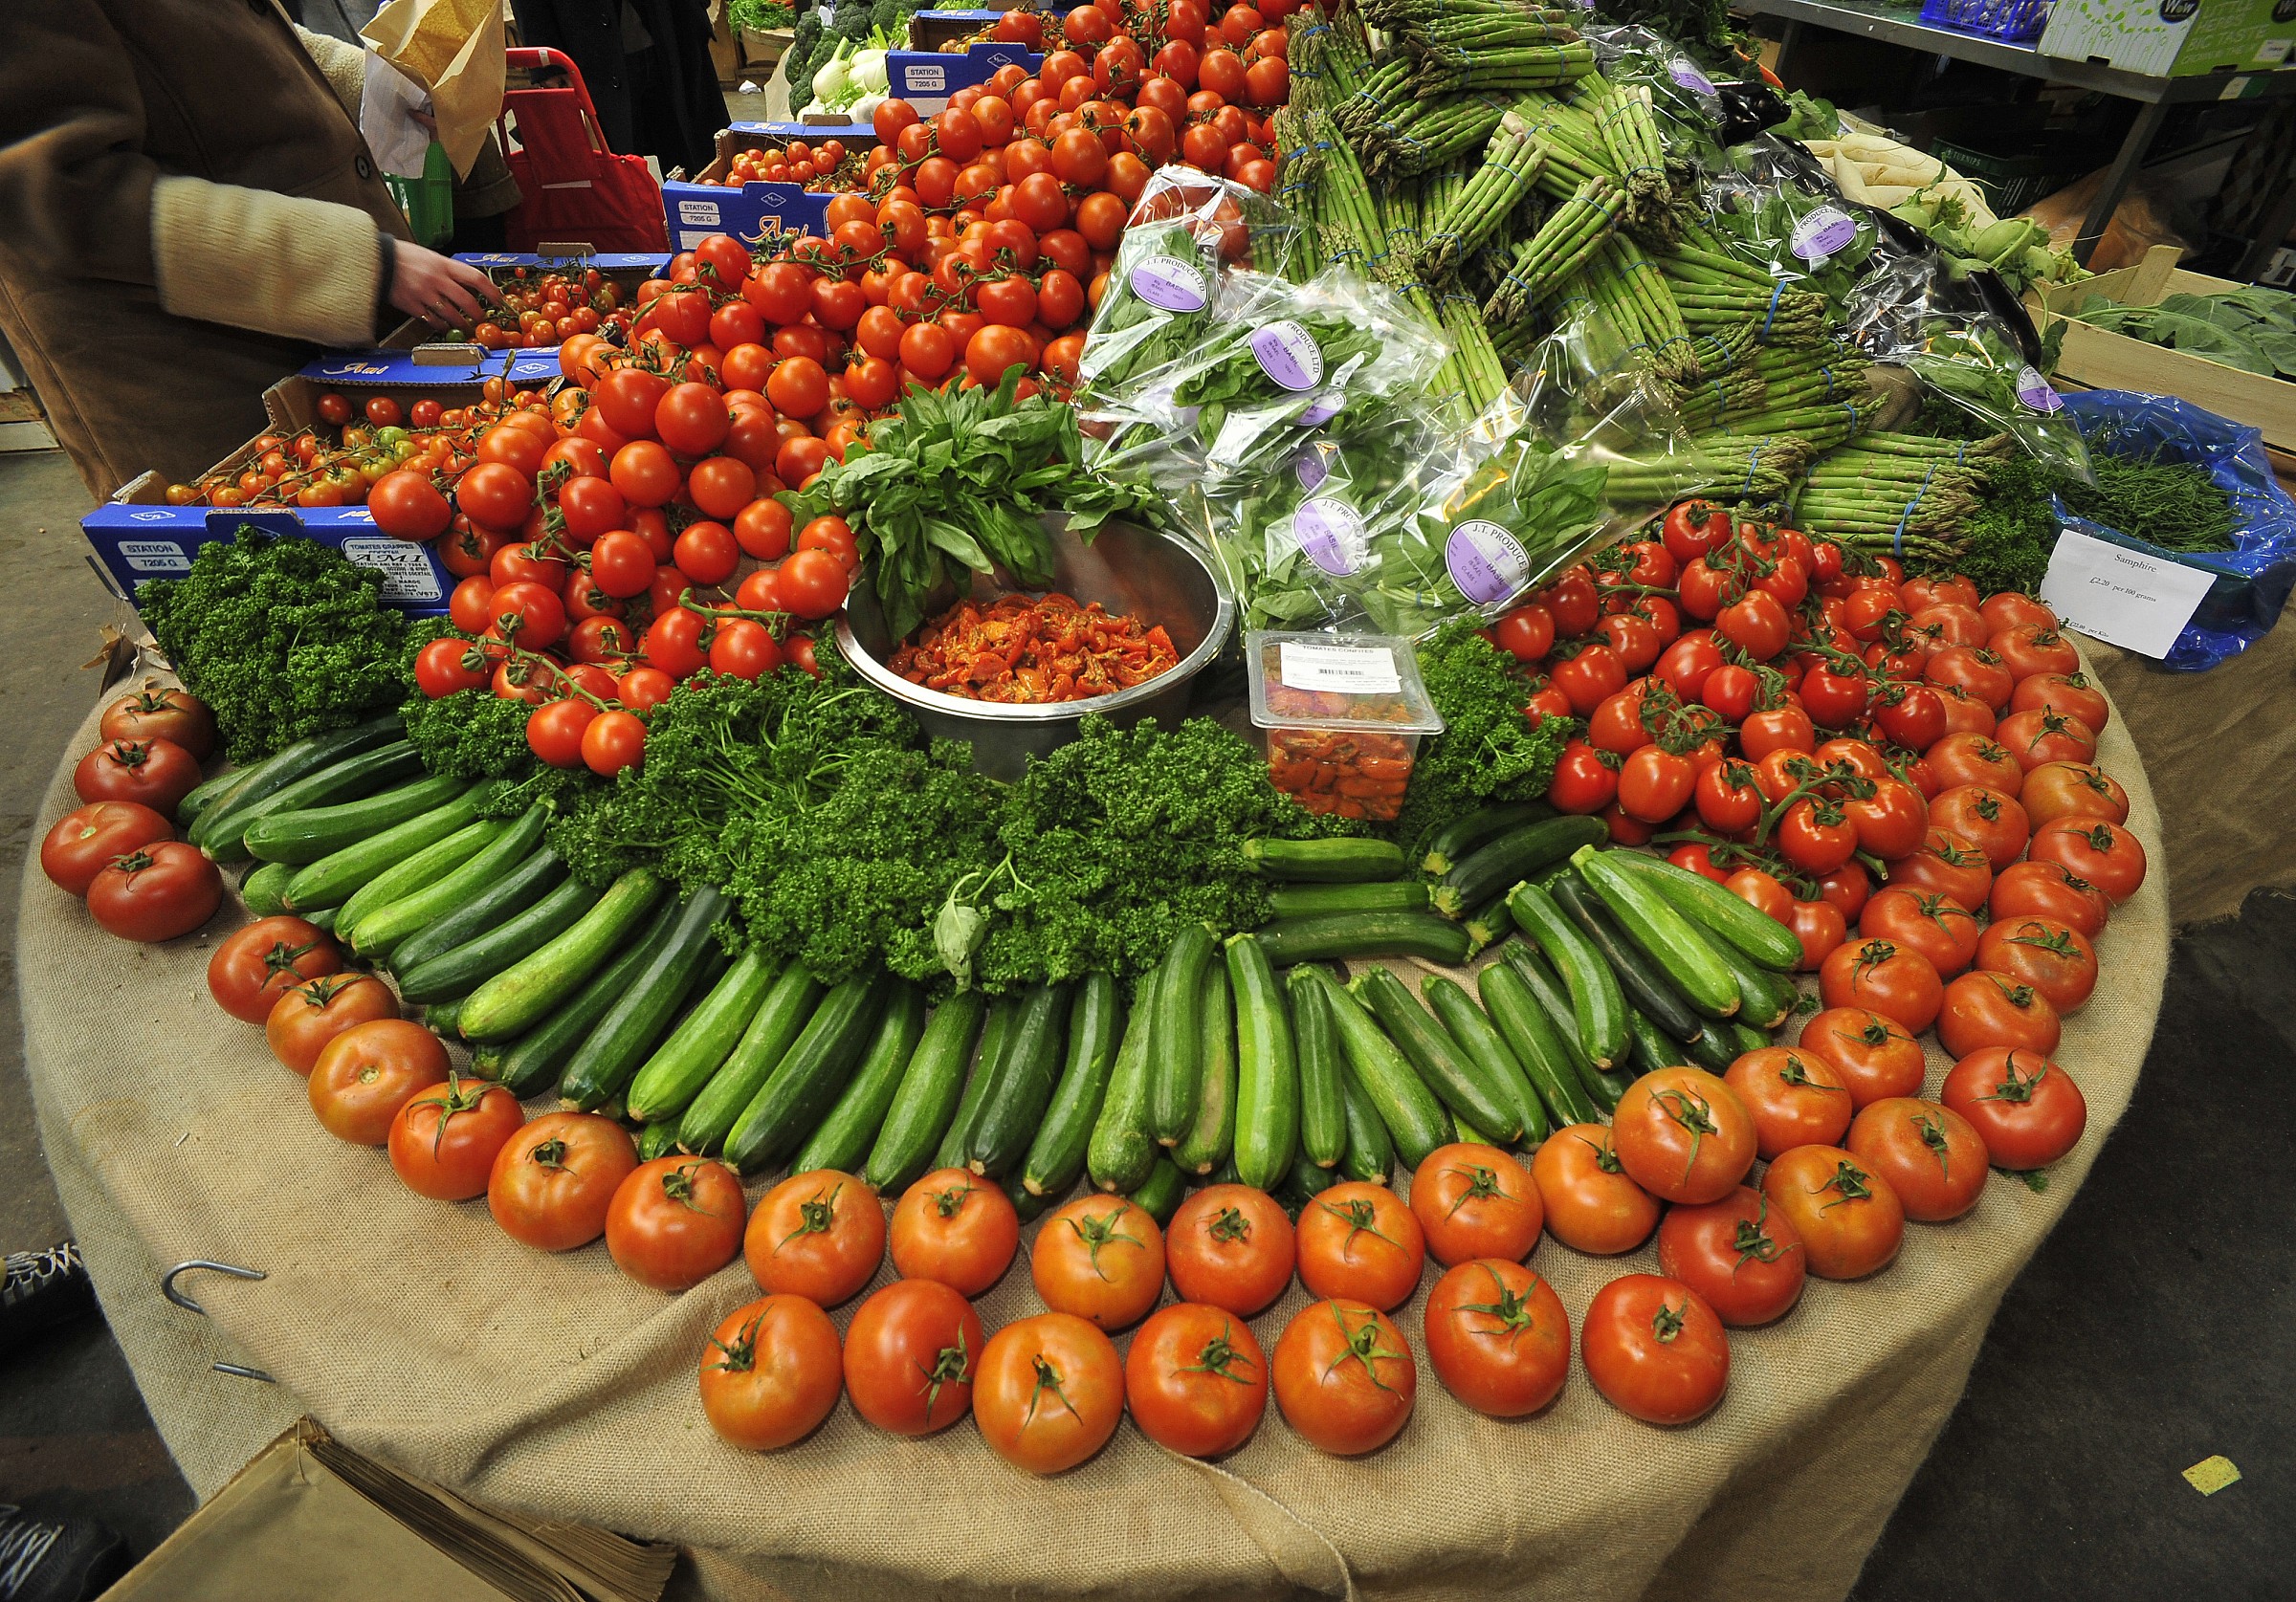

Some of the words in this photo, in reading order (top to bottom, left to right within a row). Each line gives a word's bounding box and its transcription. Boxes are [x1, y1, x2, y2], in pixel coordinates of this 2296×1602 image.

[1953, 151, 1981, 166] TURNIPS
[1799, 208, 1830, 230] PRODUCE
[740, 215, 809, 243] Ami
[1160, 257, 1197, 277] PRODUCE
[1165, 280, 1184, 293] BASIL
[1286, 322, 1317, 357] PRODUCE
[1283, 346, 1299, 368] BASIL
[322, 362, 389, 375] Ami
[1322, 500, 1336, 510] J.T.
[126, 544, 173, 553] STATION
[1324, 530, 1338, 549] BASIL
[1473, 523, 1489, 535] J.T.
[1490, 529, 1528, 569] PRODUCE
[353, 554, 426, 562] AMI
[2114, 554, 2157, 573] Samphire
[1461, 565, 1474, 582] CLASS
[1486, 562, 1506, 586] BASIL
[2088, 577, 2110, 586] £2.20
[2134, 593, 2156, 603] grams
